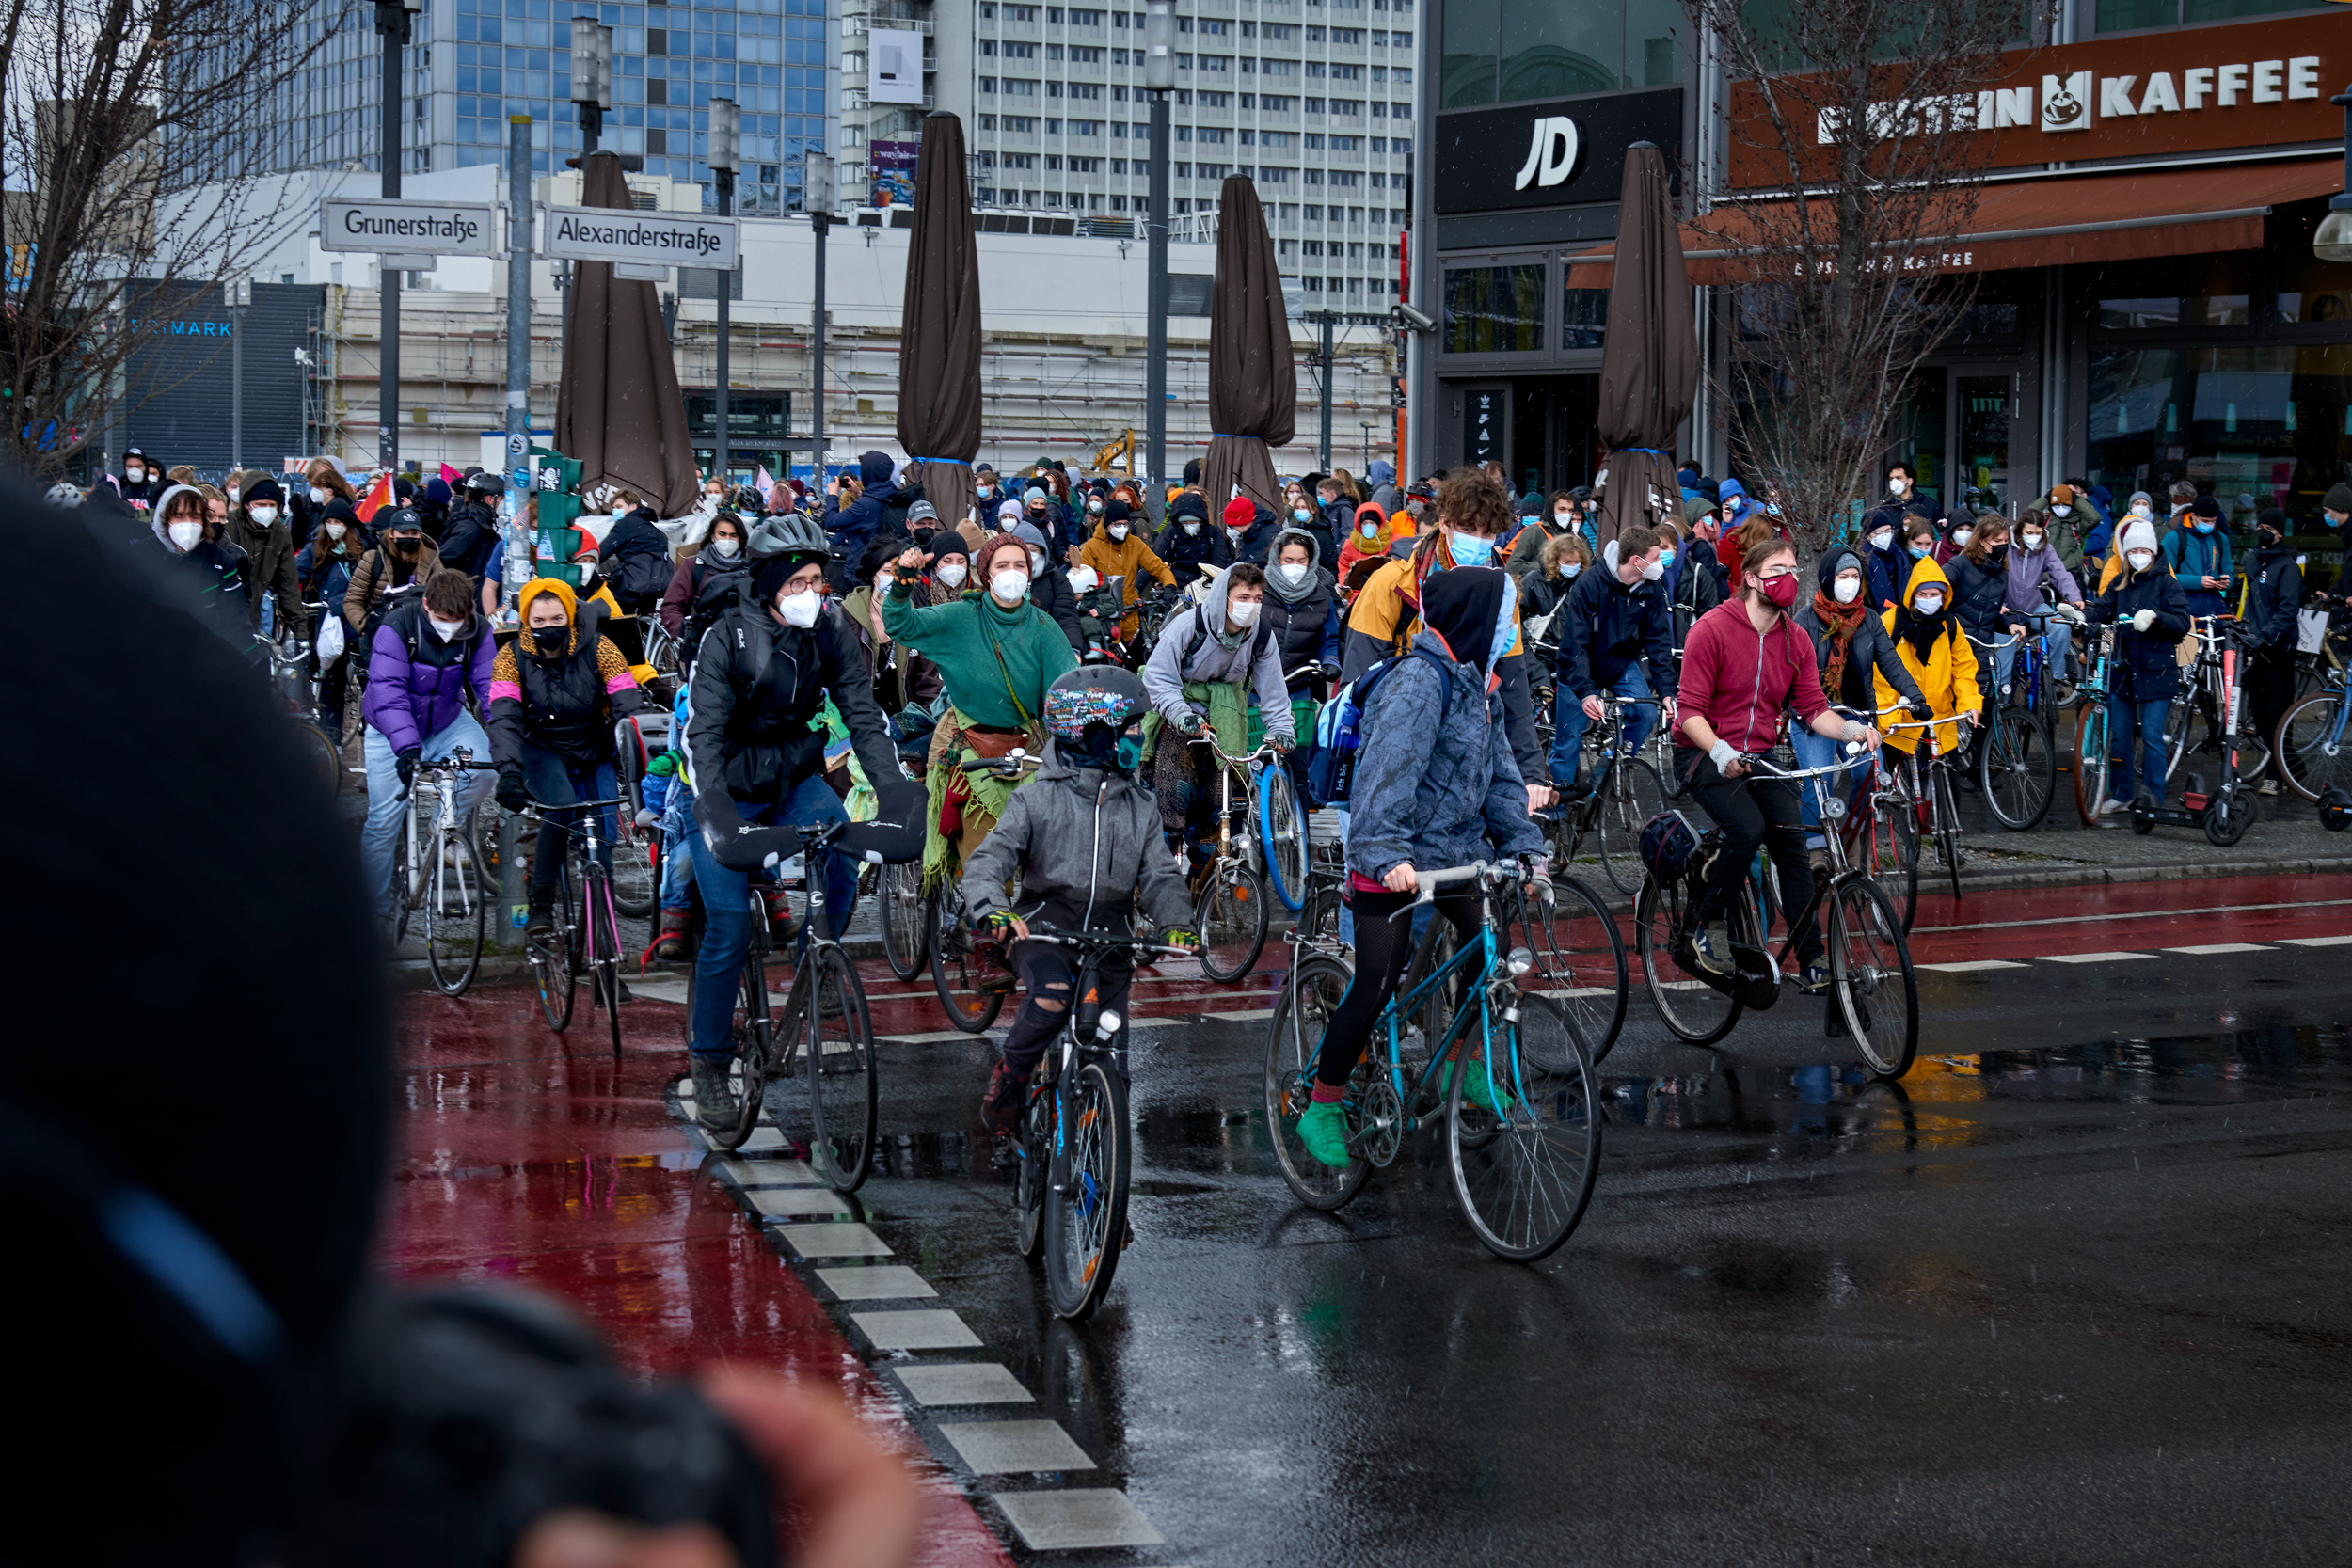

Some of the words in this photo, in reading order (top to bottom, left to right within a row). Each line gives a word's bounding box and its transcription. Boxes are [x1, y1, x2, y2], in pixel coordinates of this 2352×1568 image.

[1818, 87, 2033, 144] ENSTEIN
[2100, 56, 2320, 118] KAFFEE
[1515, 116, 1579, 191] JD
[344, 210, 479, 243] Grunerstraße
[556, 217, 722, 255] Alexanderstraße
[737, 628, 746, 649] DLX
[2228, 696, 2236, 725] BIRD
